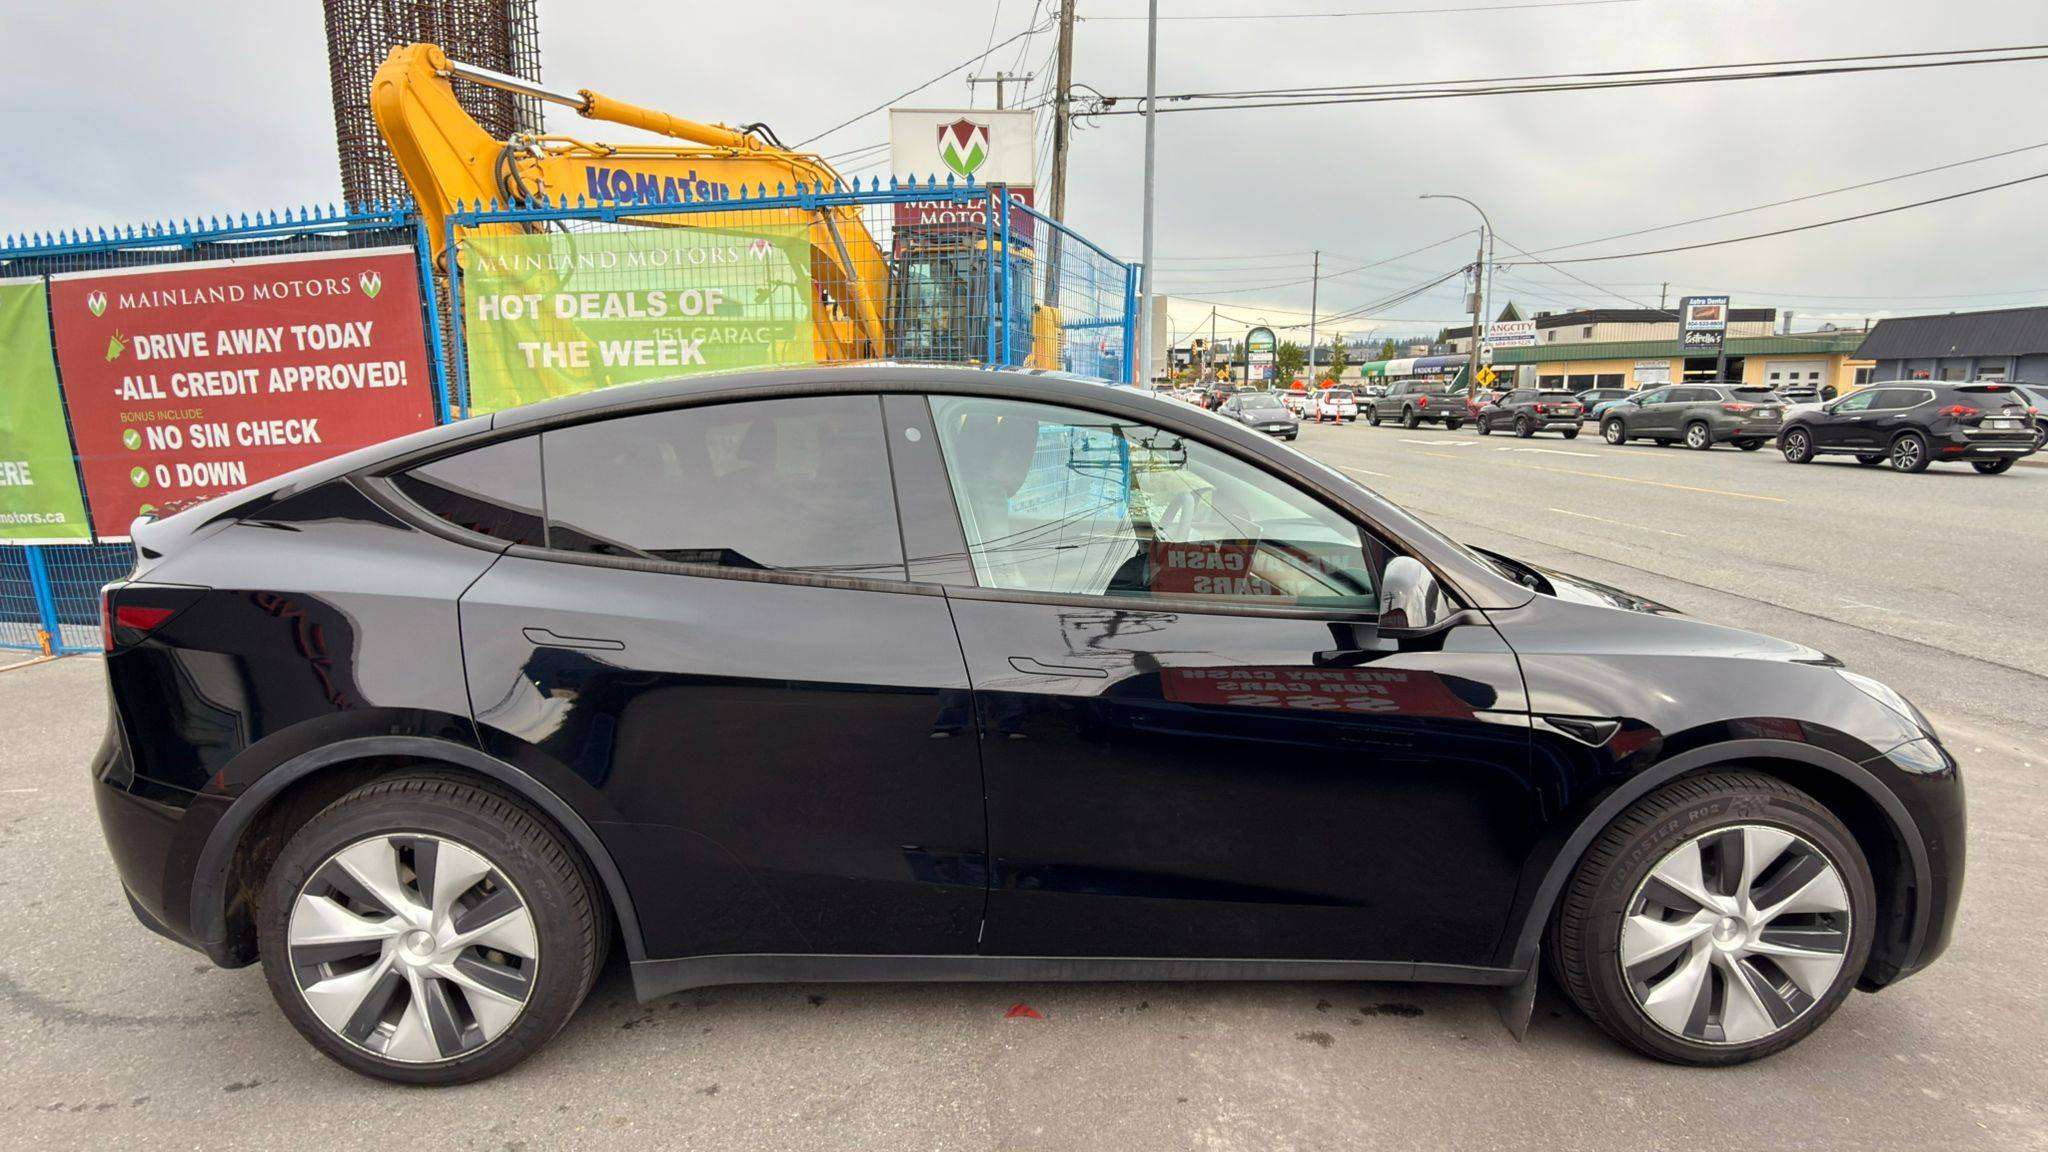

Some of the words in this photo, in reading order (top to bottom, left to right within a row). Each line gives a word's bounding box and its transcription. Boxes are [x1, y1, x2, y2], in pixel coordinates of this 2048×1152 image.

[477, 251, 617, 272] MAINLAND
[626, 247, 739, 269] MOTORS
[119, 286, 245, 310] MAINLAND
[253, 277, 351, 300] MOTORS
[478, 294, 543, 321] HOT
[555, 291, 668, 320] DEALS
[679, 288, 723, 316] OF
[133, 331, 210, 361] DRIVE
[216, 326, 284, 356] AWAY
[291, 321, 374, 350] TODAY
[690, 326, 785, 344] GARAG
[1490, 323, 1534, 332] ANGCITY
[517, 341, 590, 369] THE
[599, 338, 707, 367] WEEK
[171, 369, 260, 398] CREDIT
[268, 361, 408, 393] APPROVED!
[120, 410, 155, 423] BONUS
[156, 408, 203, 420] INCLUDE
[145, 425, 183, 451] NO
[190, 423, 231, 448] SIN
[236, 418, 321, 446] CHECK
[178, 461, 247, 487] DOWN
